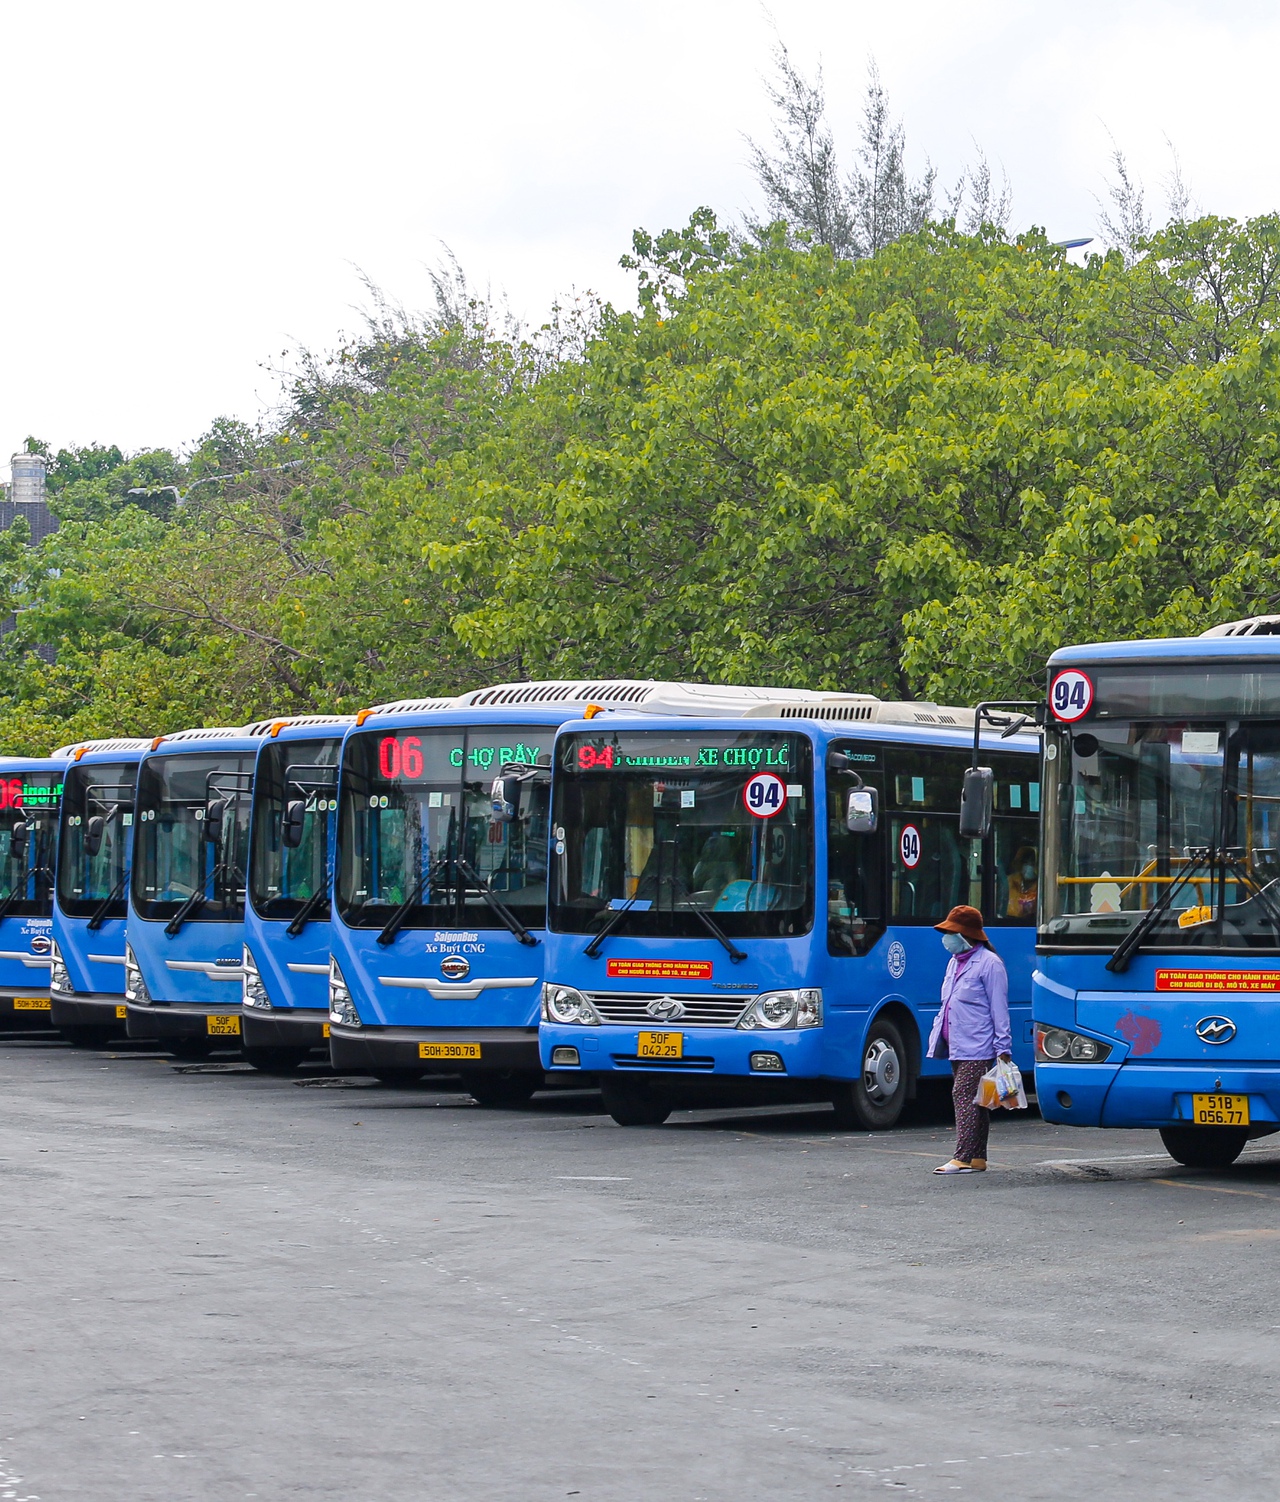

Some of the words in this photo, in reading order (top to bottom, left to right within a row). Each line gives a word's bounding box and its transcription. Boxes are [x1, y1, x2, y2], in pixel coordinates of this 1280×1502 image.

[1055, 681, 1085, 710] 94
[379, 736, 425, 779] 06
[449, 747, 495, 771] CHỢ
[578, 746, 613, 769] 94
[695, 748, 719, 766] XE
[723, 747, 763, 770] CHỢ
[0, 778, 24, 810] 06
[749, 782, 780, 808] 94
[903, 833, 918, 859] 94
[434, 931, 479, 943] SaigonBus
[425, 943, 438, 953] Xe
[439, 942, 461, 955] Buýt
[462, 943, 485, 953] CNG
[1170, 972, 1187, 980] TOÀN
[1205, 972, 1227, 980] THÔNG
[1242, 973, 1261, 981] HÀNH
[1226, 981, 1238, 989] MÔ
[215, 1016, 230, 1025] 50F
[211, 1025, 237, 1034] 002.24
[650, 1033, 669, 1044] 50F
[642, 1045, 677, 1057] 042.25
[1208, 1096, 1233, 1109] 51B
[1200, 1110, 1243, 1124] 056.77
